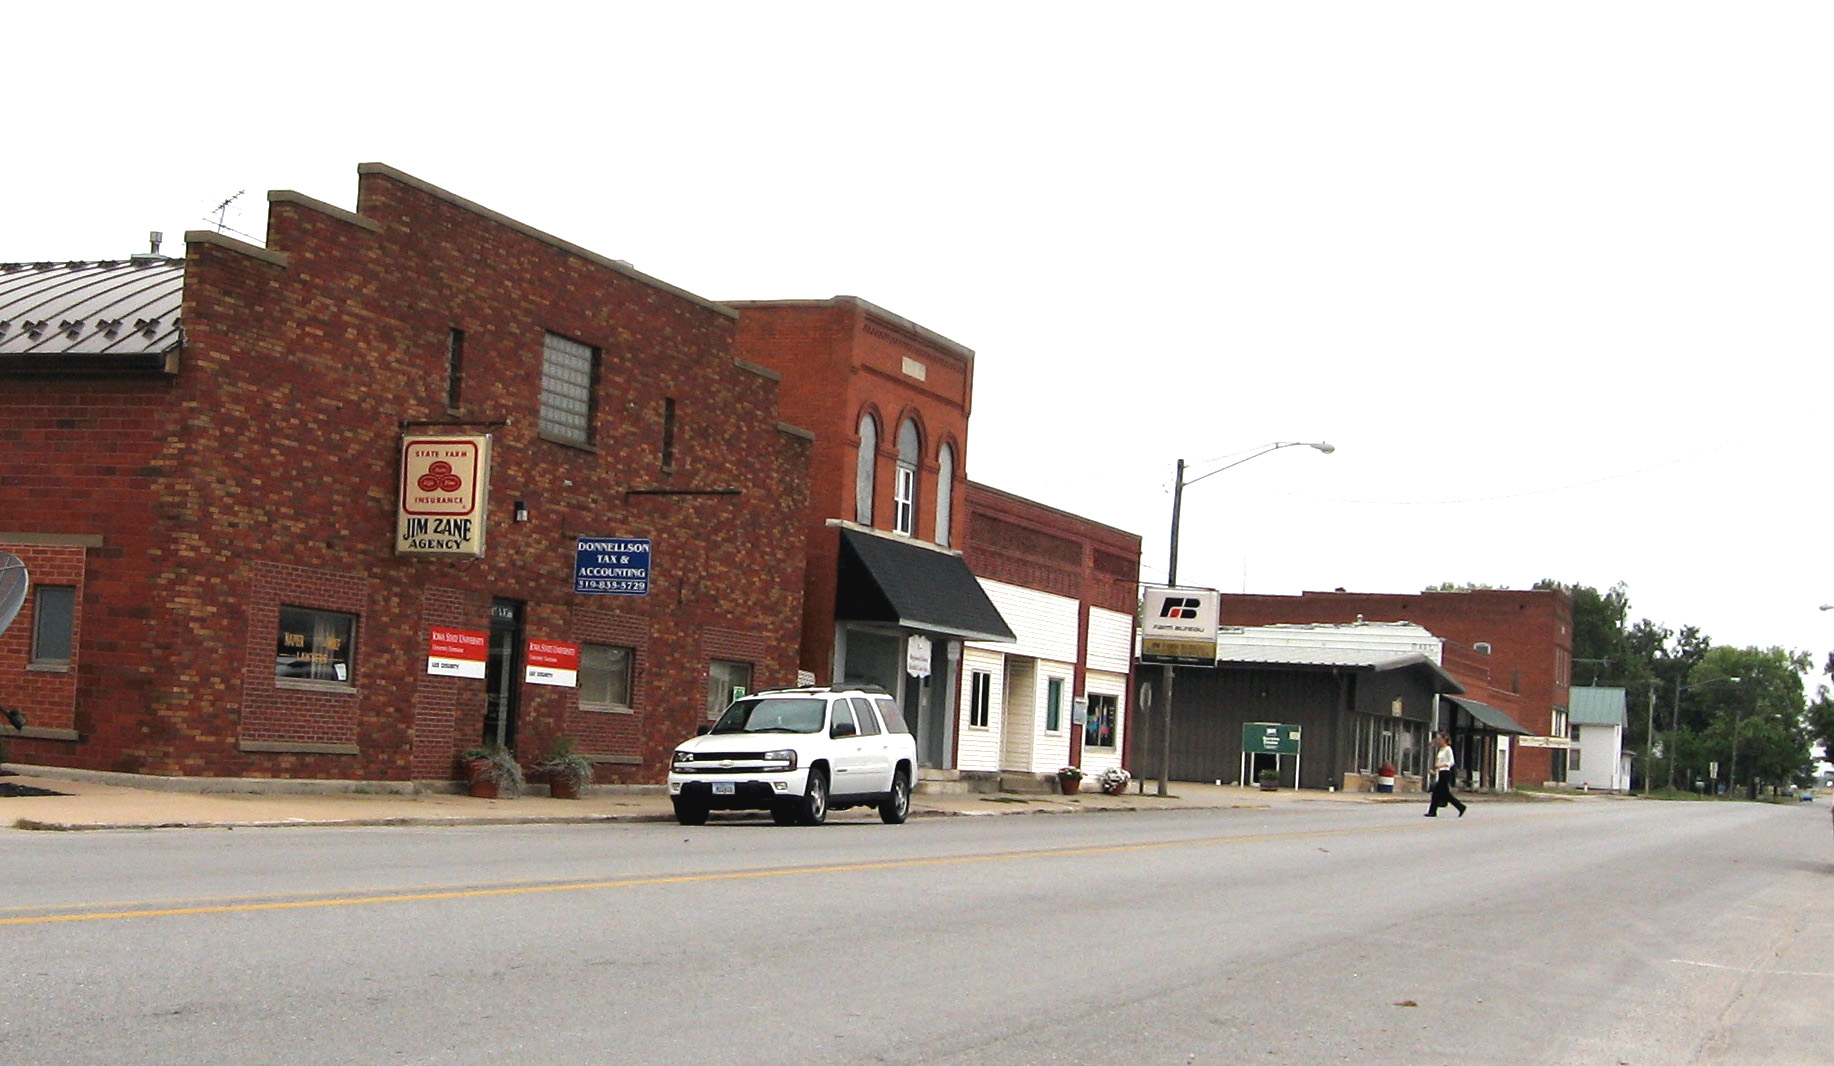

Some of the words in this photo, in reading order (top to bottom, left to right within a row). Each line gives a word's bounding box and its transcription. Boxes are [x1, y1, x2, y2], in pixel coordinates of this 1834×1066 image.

[403, 518, 428, 540] JIM
[433, 518, 472, 541] ZANE
[408, 539, 462, 549] AGENCY
[578, 542, 649, 553] DONNELLSON
[597, 554, 617, 563] TAX
[620, 555, 630, 564] &
[578, 567, 646, 578] ACCOUNTING
